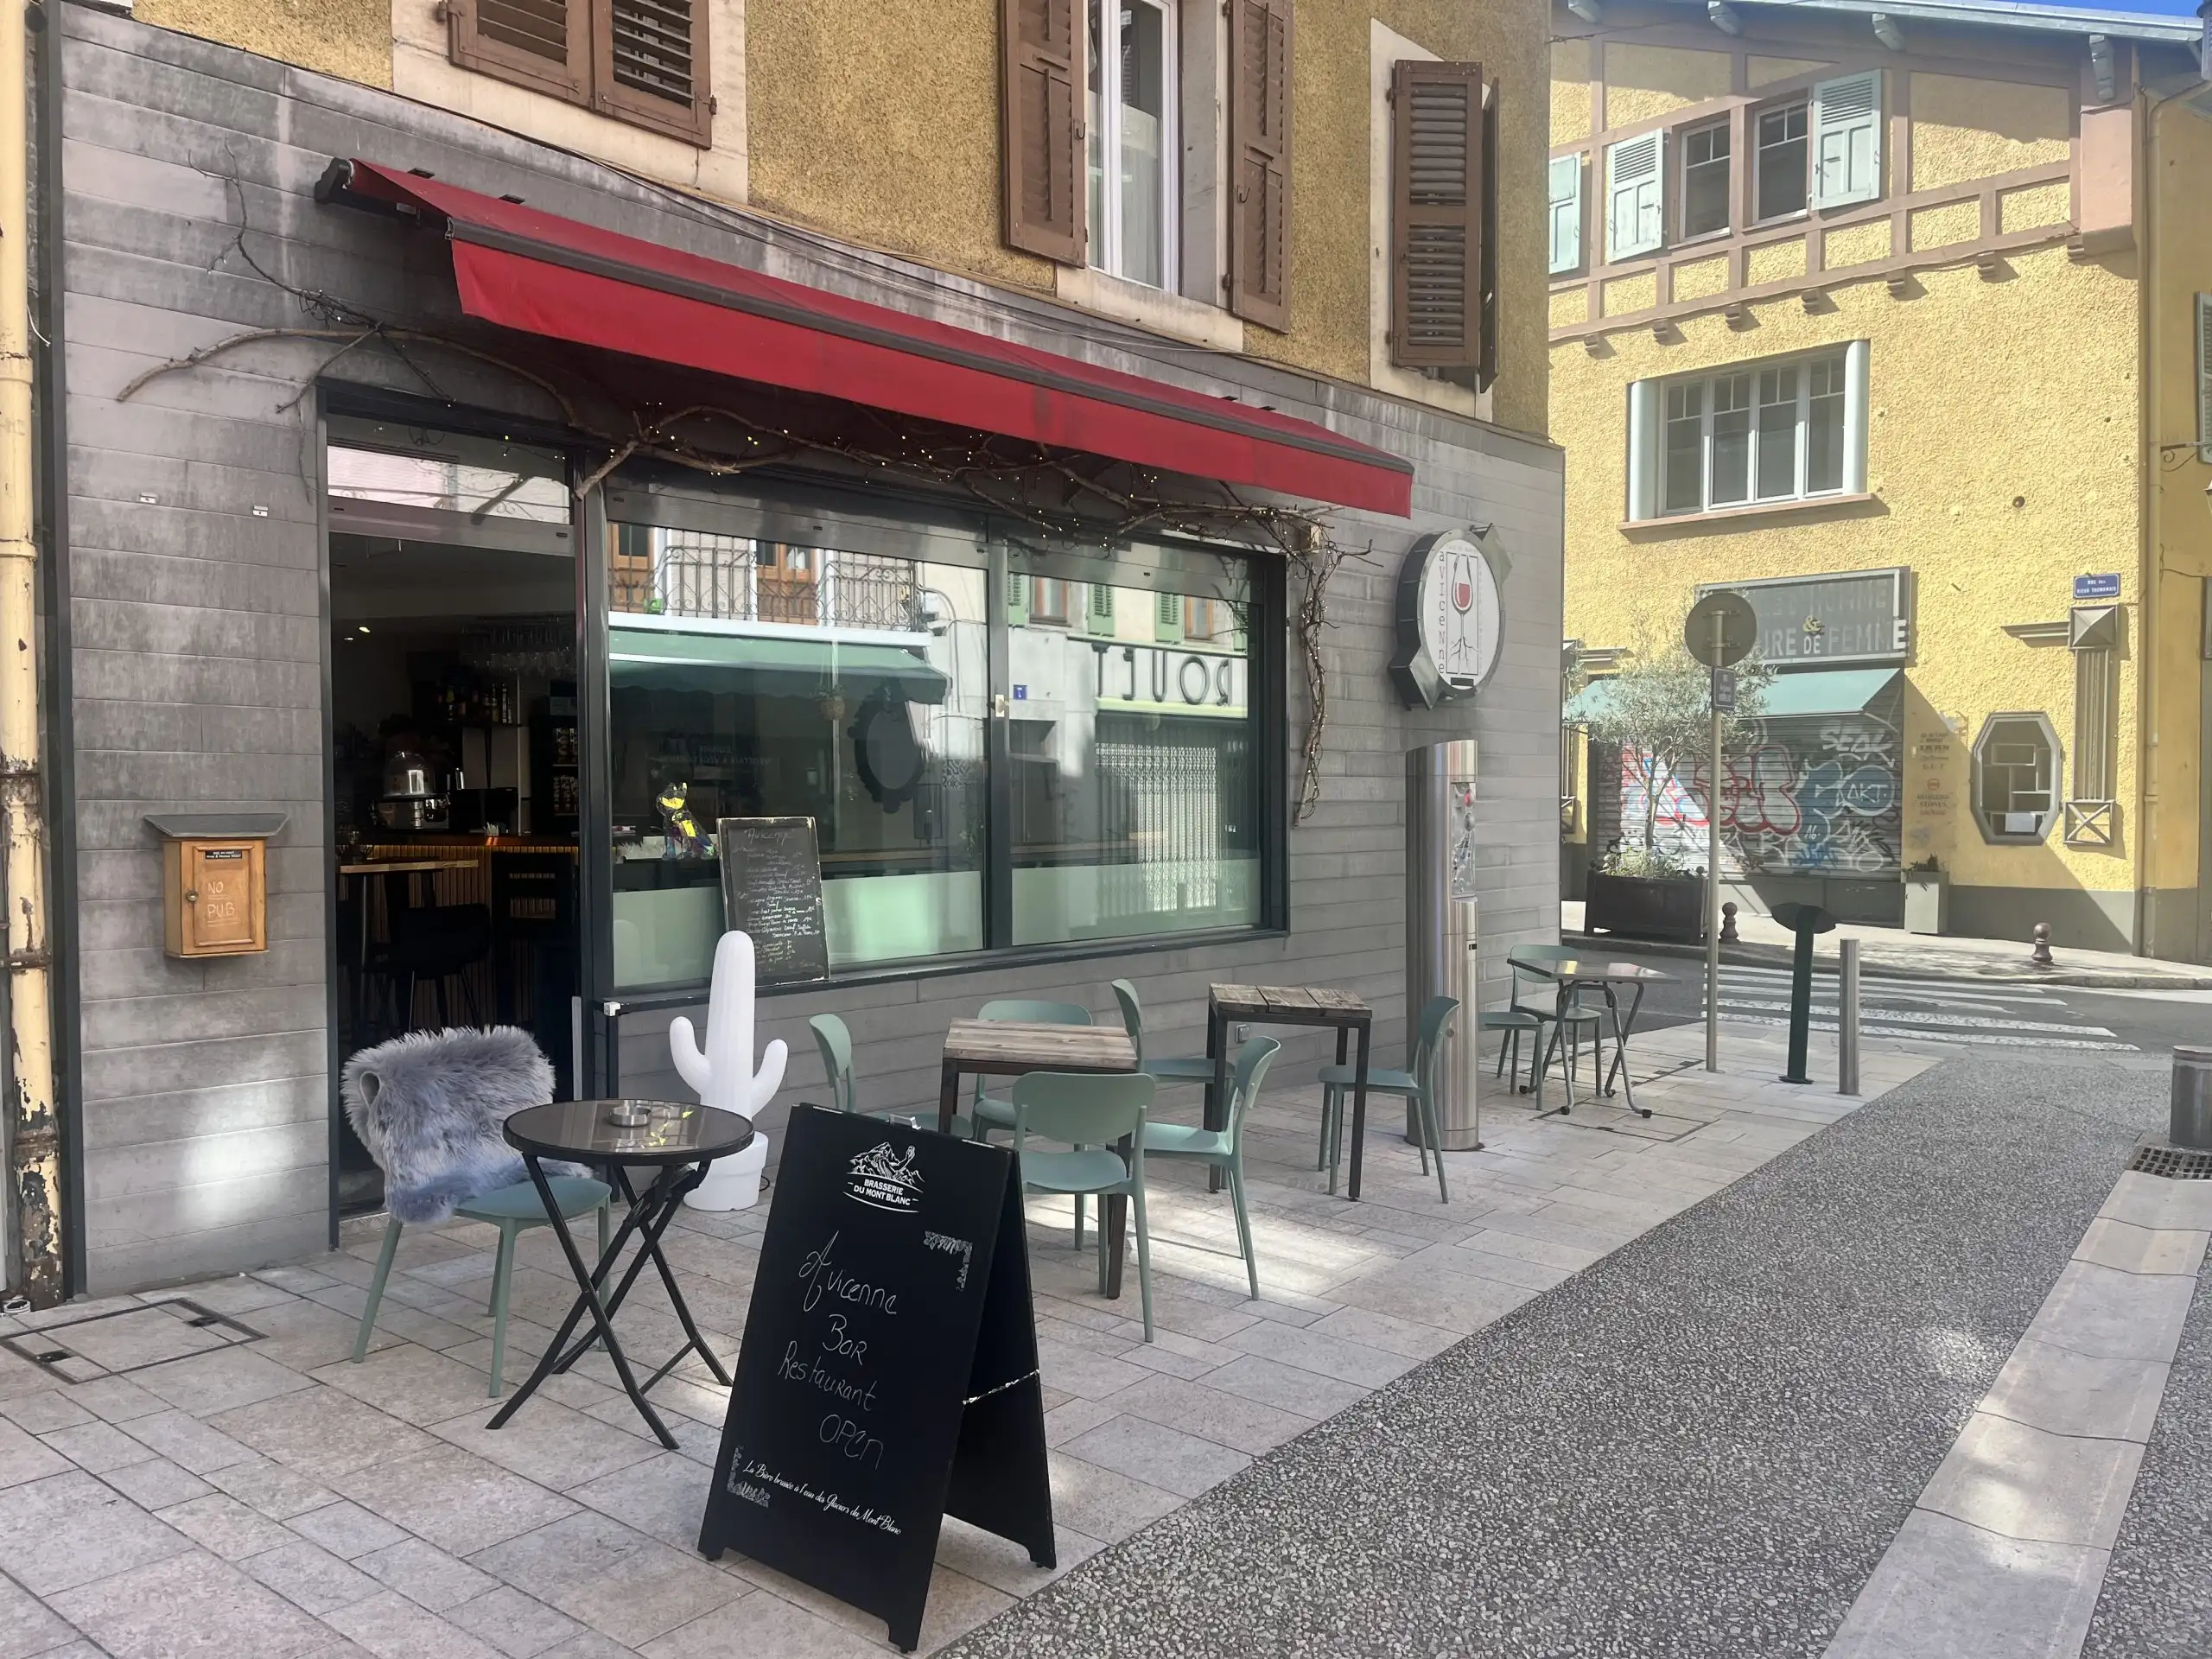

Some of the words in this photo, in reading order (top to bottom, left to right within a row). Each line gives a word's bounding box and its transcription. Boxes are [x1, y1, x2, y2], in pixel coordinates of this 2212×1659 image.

[1803, 634, 1821, 655] DE
[207, 880, 224, 894] NO
[207, 901, 236, 918] PUB
[853, 1185, 865, 1194] DU
[865, 1188, 887, 1200] MONT
[886, 1193, 912, 1206] BLANC
[864, 1179, 904, 1196] BRASSERIE
[742, 1460, 755, 1474] La
[755, 1464, 774, 1482] Bière
[815, 1491, 825, 1503] des
[823, 1493, 850, 1513] Glaciers
[849, 1505, 861, 1518] du
[856, 1509, 882, 1526] Mont
[880, 1516, 902, 1535] Blanc
